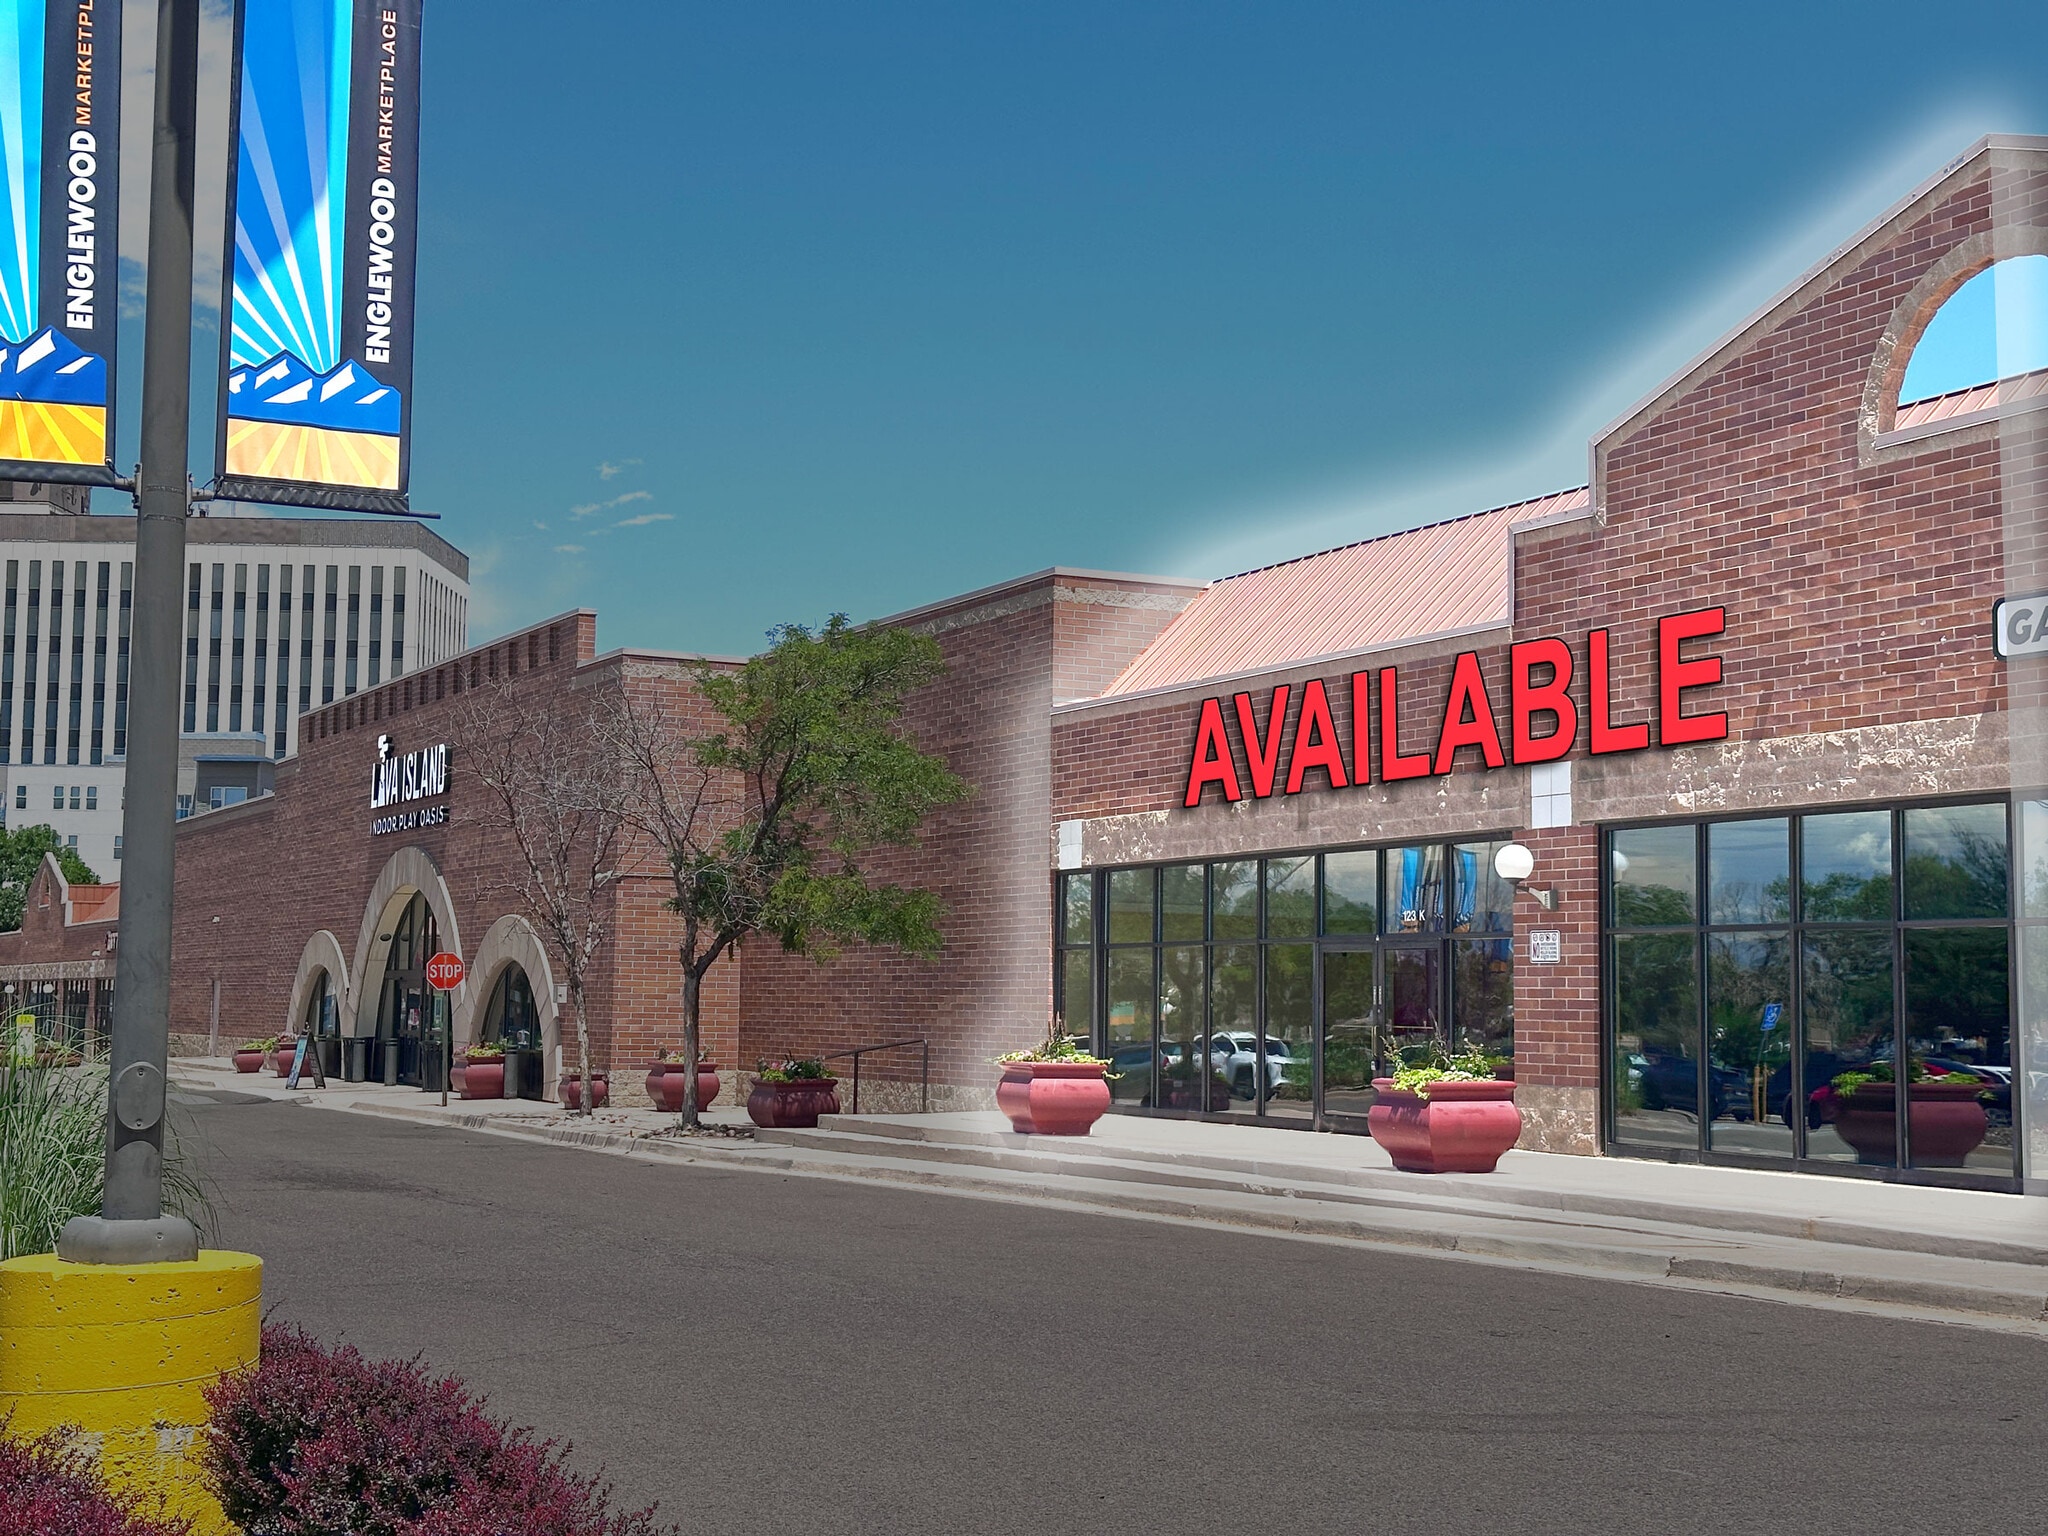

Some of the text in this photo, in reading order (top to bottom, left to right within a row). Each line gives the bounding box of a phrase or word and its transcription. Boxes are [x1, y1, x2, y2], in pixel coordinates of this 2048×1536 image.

[365, 10, 397, 363] ENGLEWOOD MARKETPLACE
[66, 130, 97, 330] ENGLEWOOD
[370, 744, 445, 809] LAVA ISLAND
[370, 805, 444, 835] INDOOR PLAY OASIS
[1403, 909, 1426, 921] 123 K
[430, 964, 462, 978] STOP
